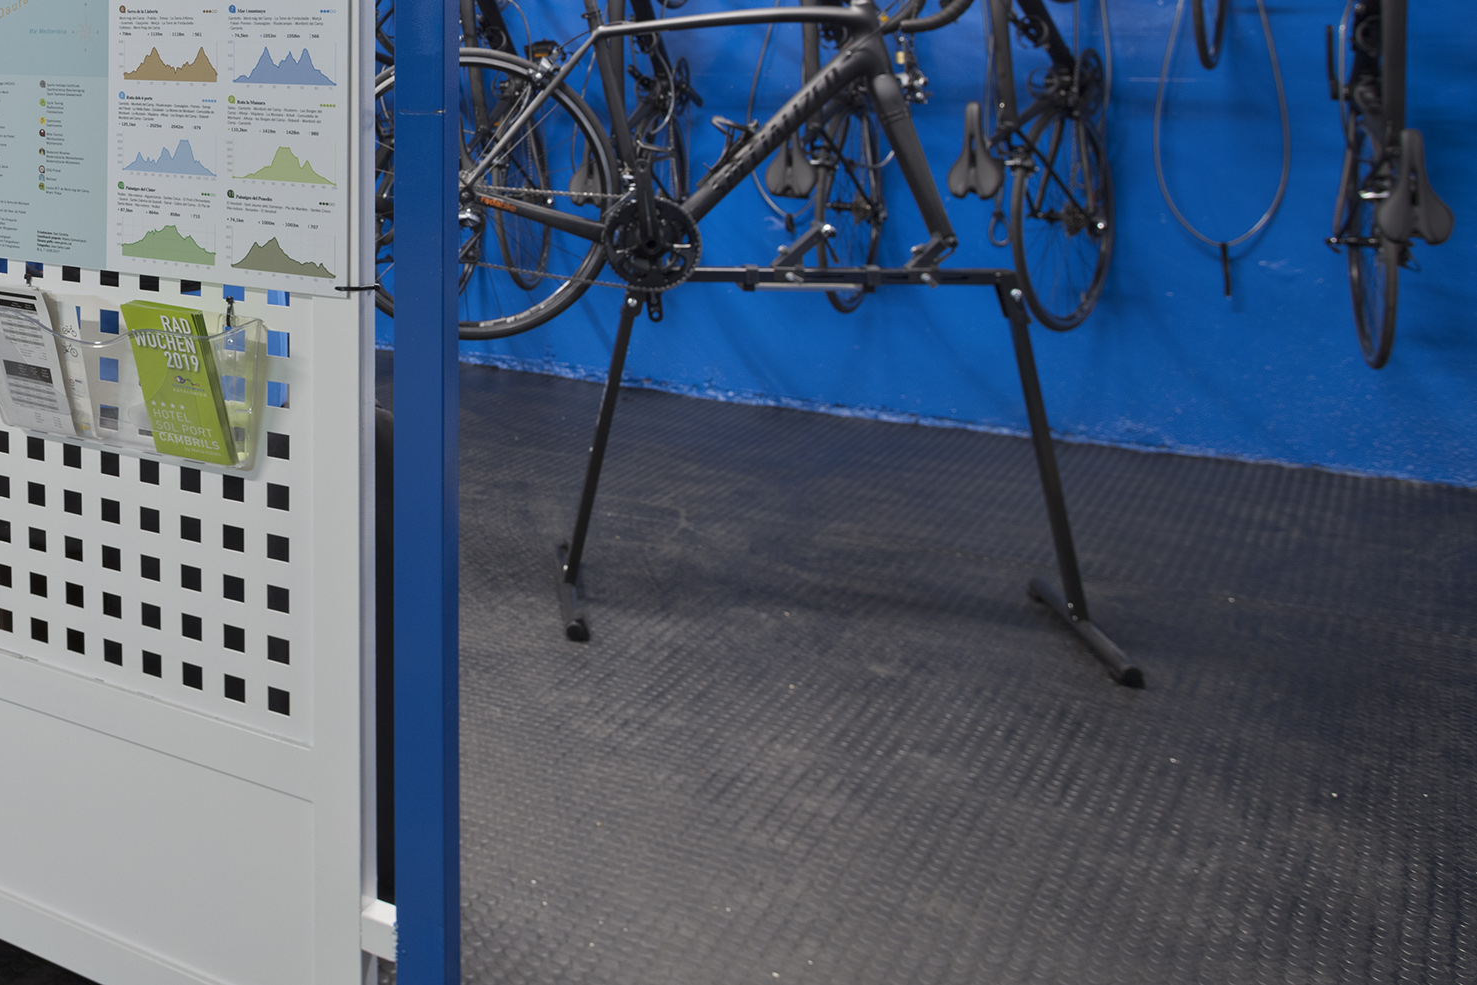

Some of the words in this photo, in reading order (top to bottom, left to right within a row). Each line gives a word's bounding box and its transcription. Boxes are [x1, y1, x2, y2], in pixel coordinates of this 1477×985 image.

[160, 315, 191, 335] RAD
[133, 331, 196, 354] WOCHEN
[164, 351, 199, 372] 2019
[173, 388, 207, 397] KATALONIEN
[153, 408, 191, 423] HOTEL
[155, 421, 178, 433] SOL
[182, 425, 212, 438] PORT
[159, 433, 220, 451] CAMBRILS
